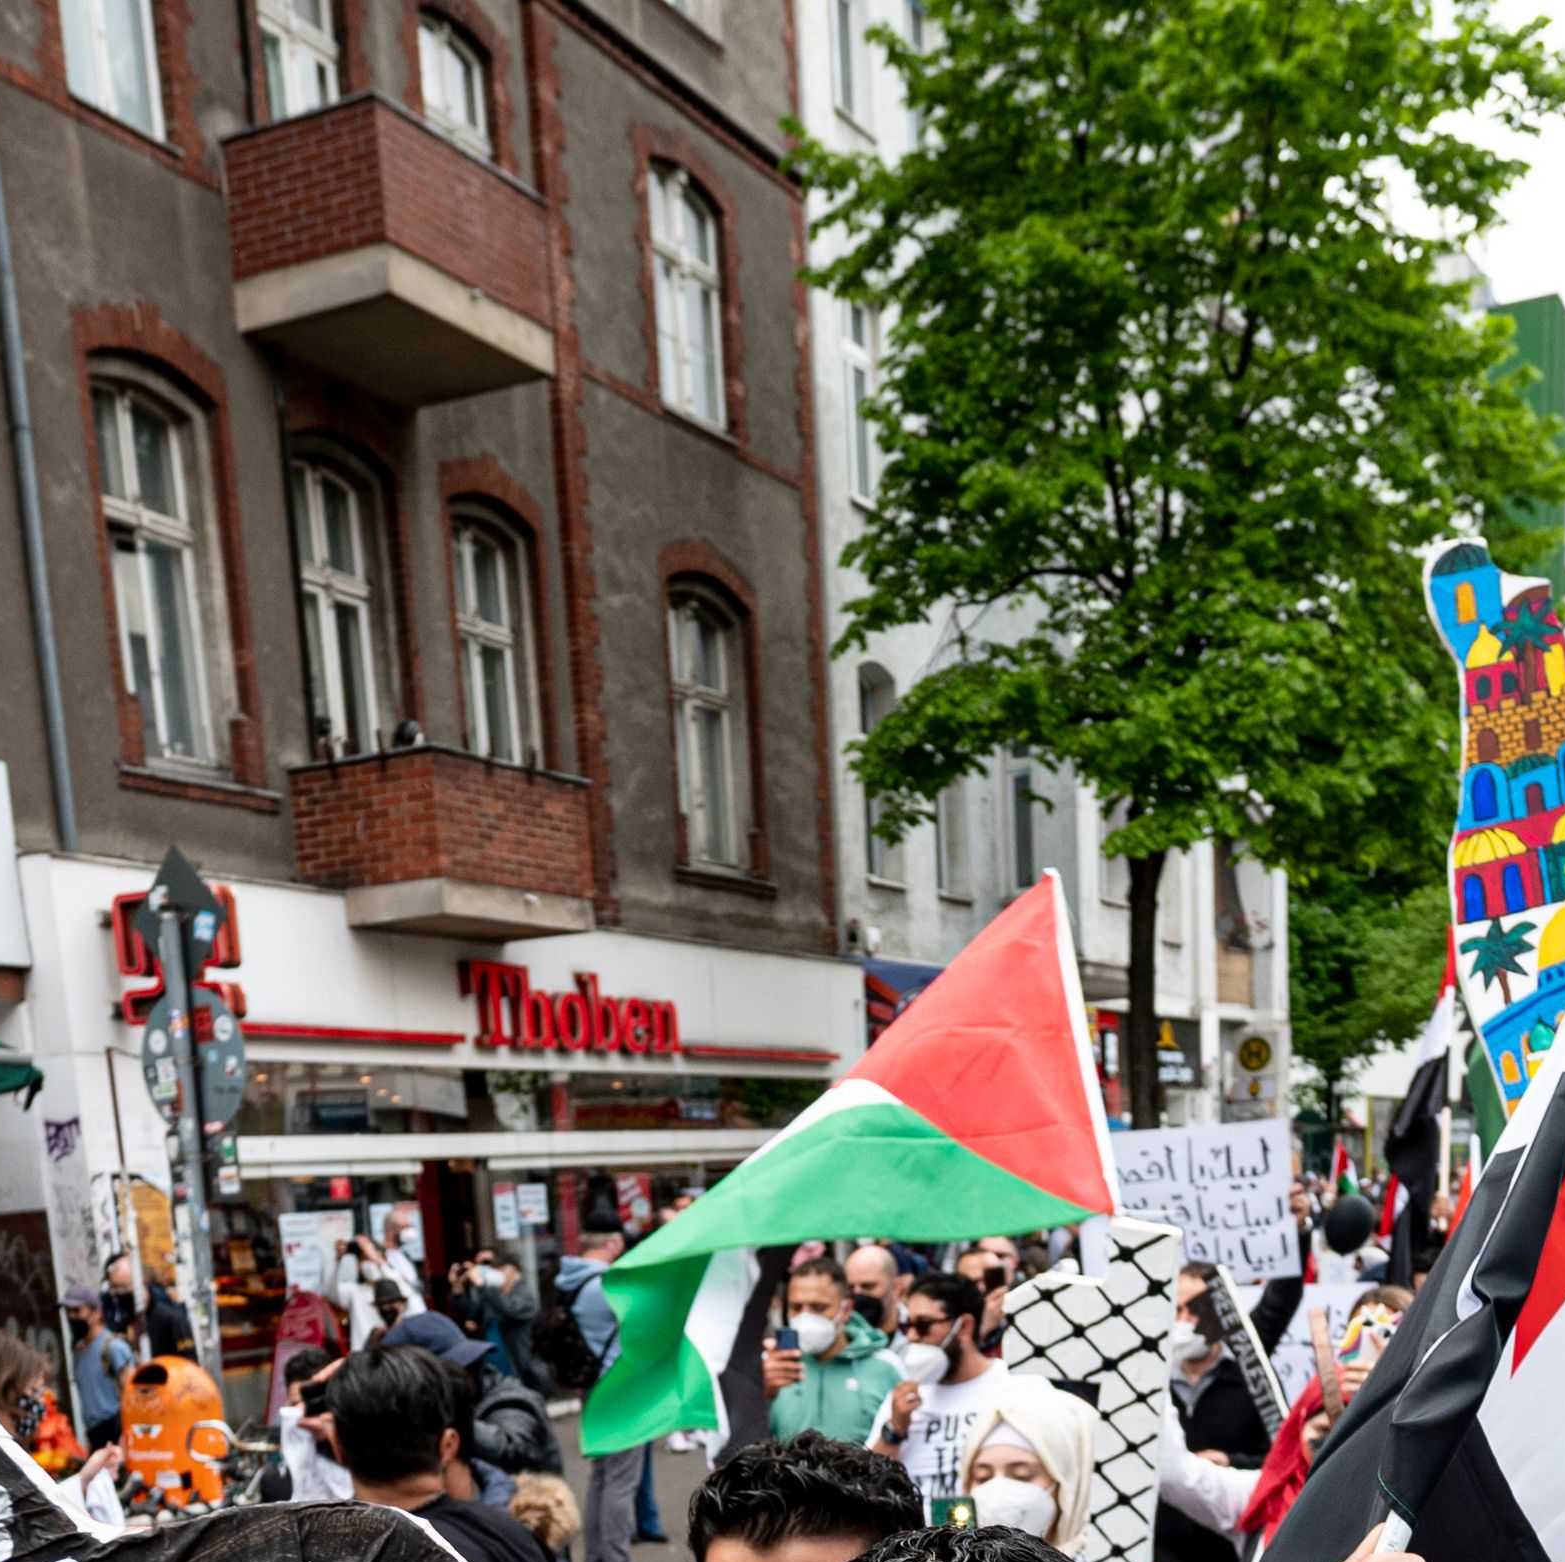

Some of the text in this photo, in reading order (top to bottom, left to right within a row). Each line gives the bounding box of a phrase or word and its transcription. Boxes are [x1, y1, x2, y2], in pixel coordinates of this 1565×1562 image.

[459, 959, 682, 1053] Thoben
[1208, 1275, 1242, 1332] FREE
[924, 1412, 978, 1443] PUS
